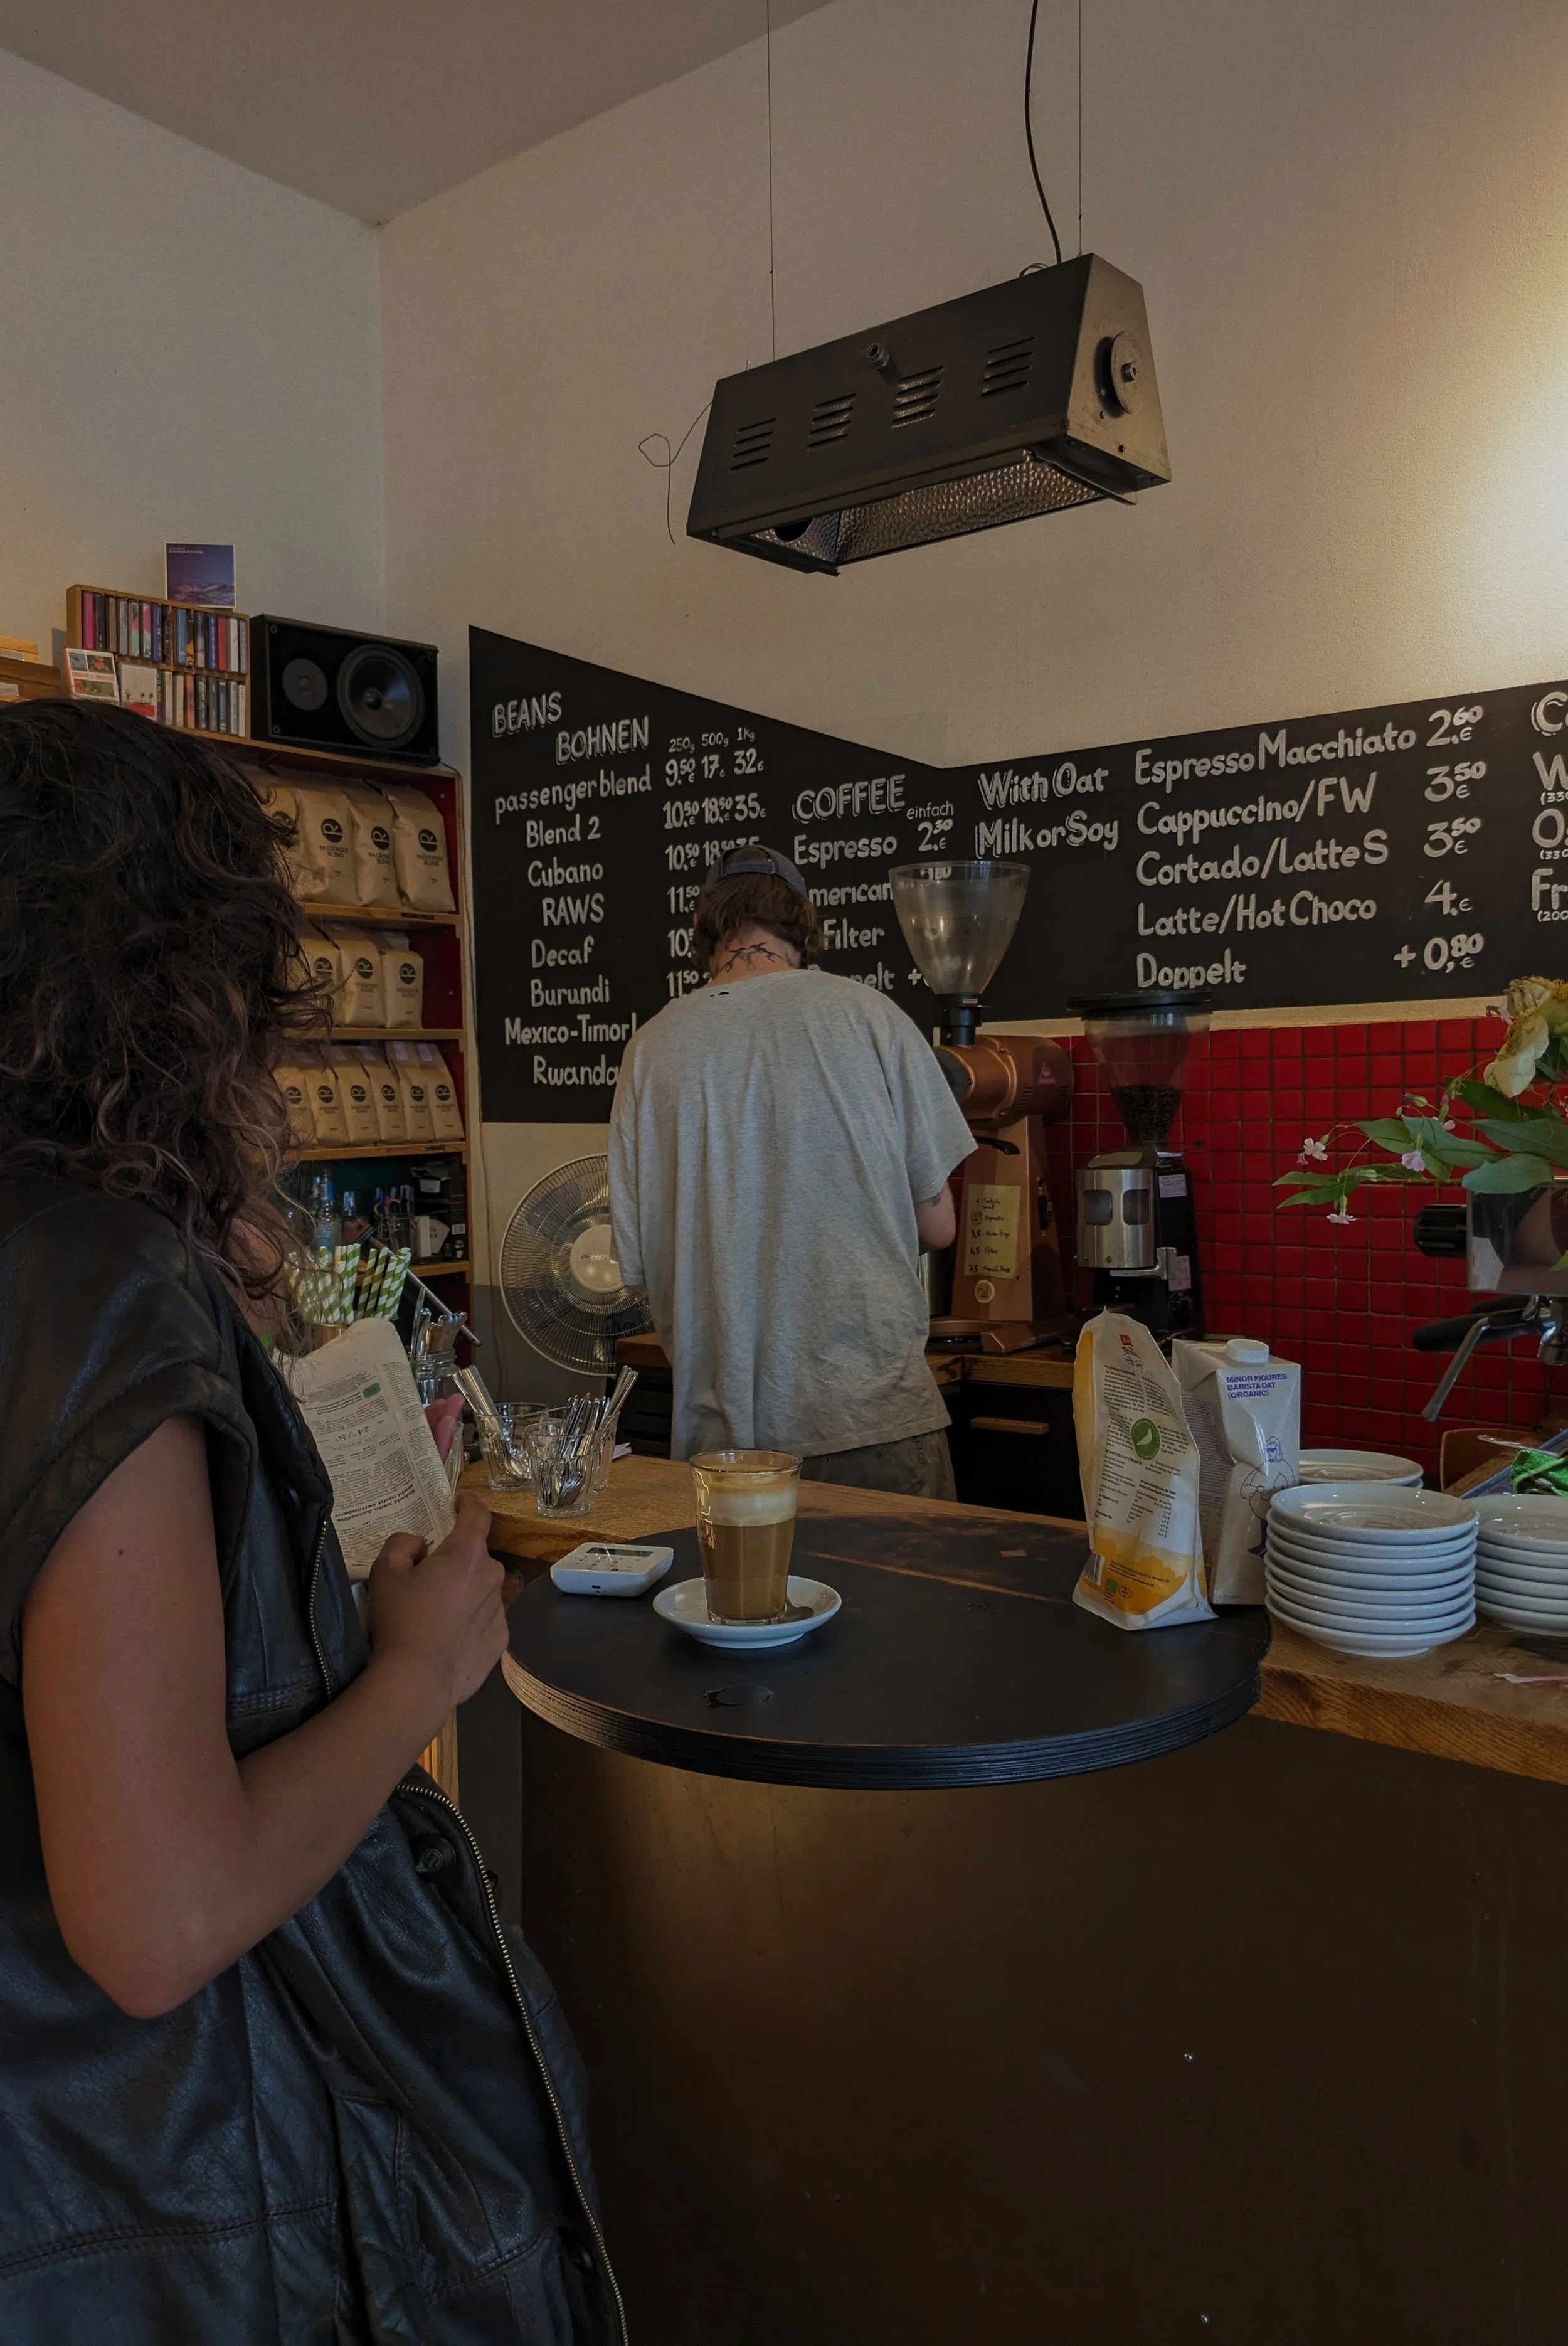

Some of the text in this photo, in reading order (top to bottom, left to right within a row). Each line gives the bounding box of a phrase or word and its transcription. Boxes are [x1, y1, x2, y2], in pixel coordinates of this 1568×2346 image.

[492, 691, 563, 738] BEANS
[556, 716, 649, 765] BOHNEN
[668, 736, 695, 753] 250g
[701, 732, 729, 747] 500g
[1134, 721, 1416, 793] Espresso Macchiato
[495, 763, 652, 824] passenger blend
[792, 774, 906, 824] COFFEE
[978, 762, 1109, 810] With Oat
[906, 801, 955, 820] einfach
[526, 814, 602, 849] Blend 2
[975, 810, 1118, 859] Milk or Soy
[1363, 829, 1389, 865] S
[793, 834, 898, 869] Espresso
[527, 857, 603, 888] Cubano
[1531, 868, 1568, 911] Fr
[541, 893, 605, 926] RAWS
[808, 883, 894, 907] merican
[1288, 890, 1377, 926] Choco
[823, 917, 886, 950] Filter
[531, 935, 595, 969] Decaf
[1136, 948, 1246, 990] Doppelt
[530, 974, 610, 1007] Burundi
[533, 1054, 620, 1086] Rwanda
[1228, 1390, 1269, 1399] (ORGANIC)
